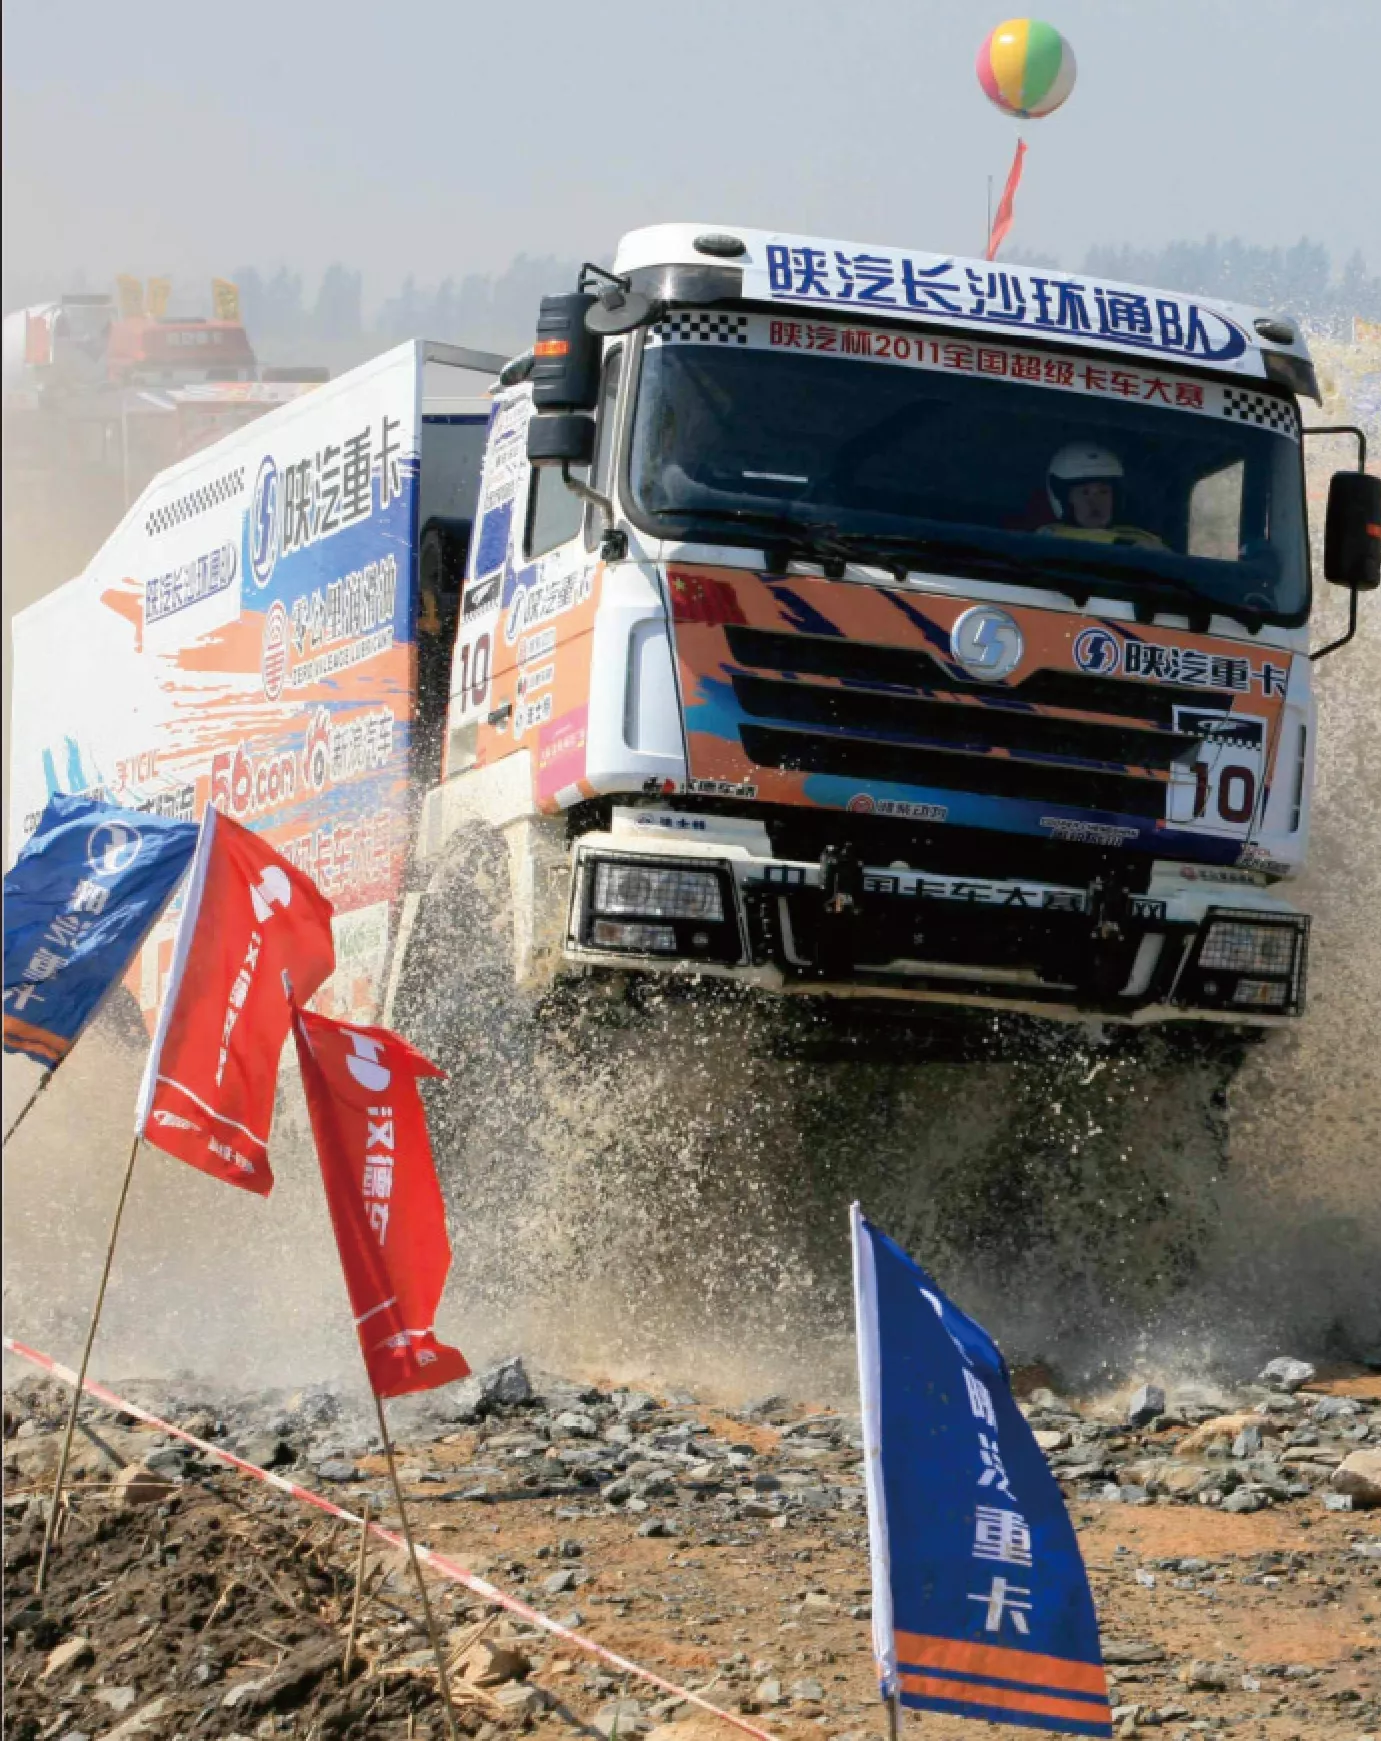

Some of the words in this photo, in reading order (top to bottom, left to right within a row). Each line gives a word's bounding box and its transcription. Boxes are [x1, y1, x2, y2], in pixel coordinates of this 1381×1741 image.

[766, 244, 1212, 354] 陕汽长沙环通队
[769, 320, 1205, 410] 陕汽杯2011全国超级卡车大赛
[282, 415, 401, 552] 陕汽重卡
[461, 633, 491, 714] 10
[1124, 641, 1286, 697] 陕汽重卡
[1193, 761, 1256, 824] 10
